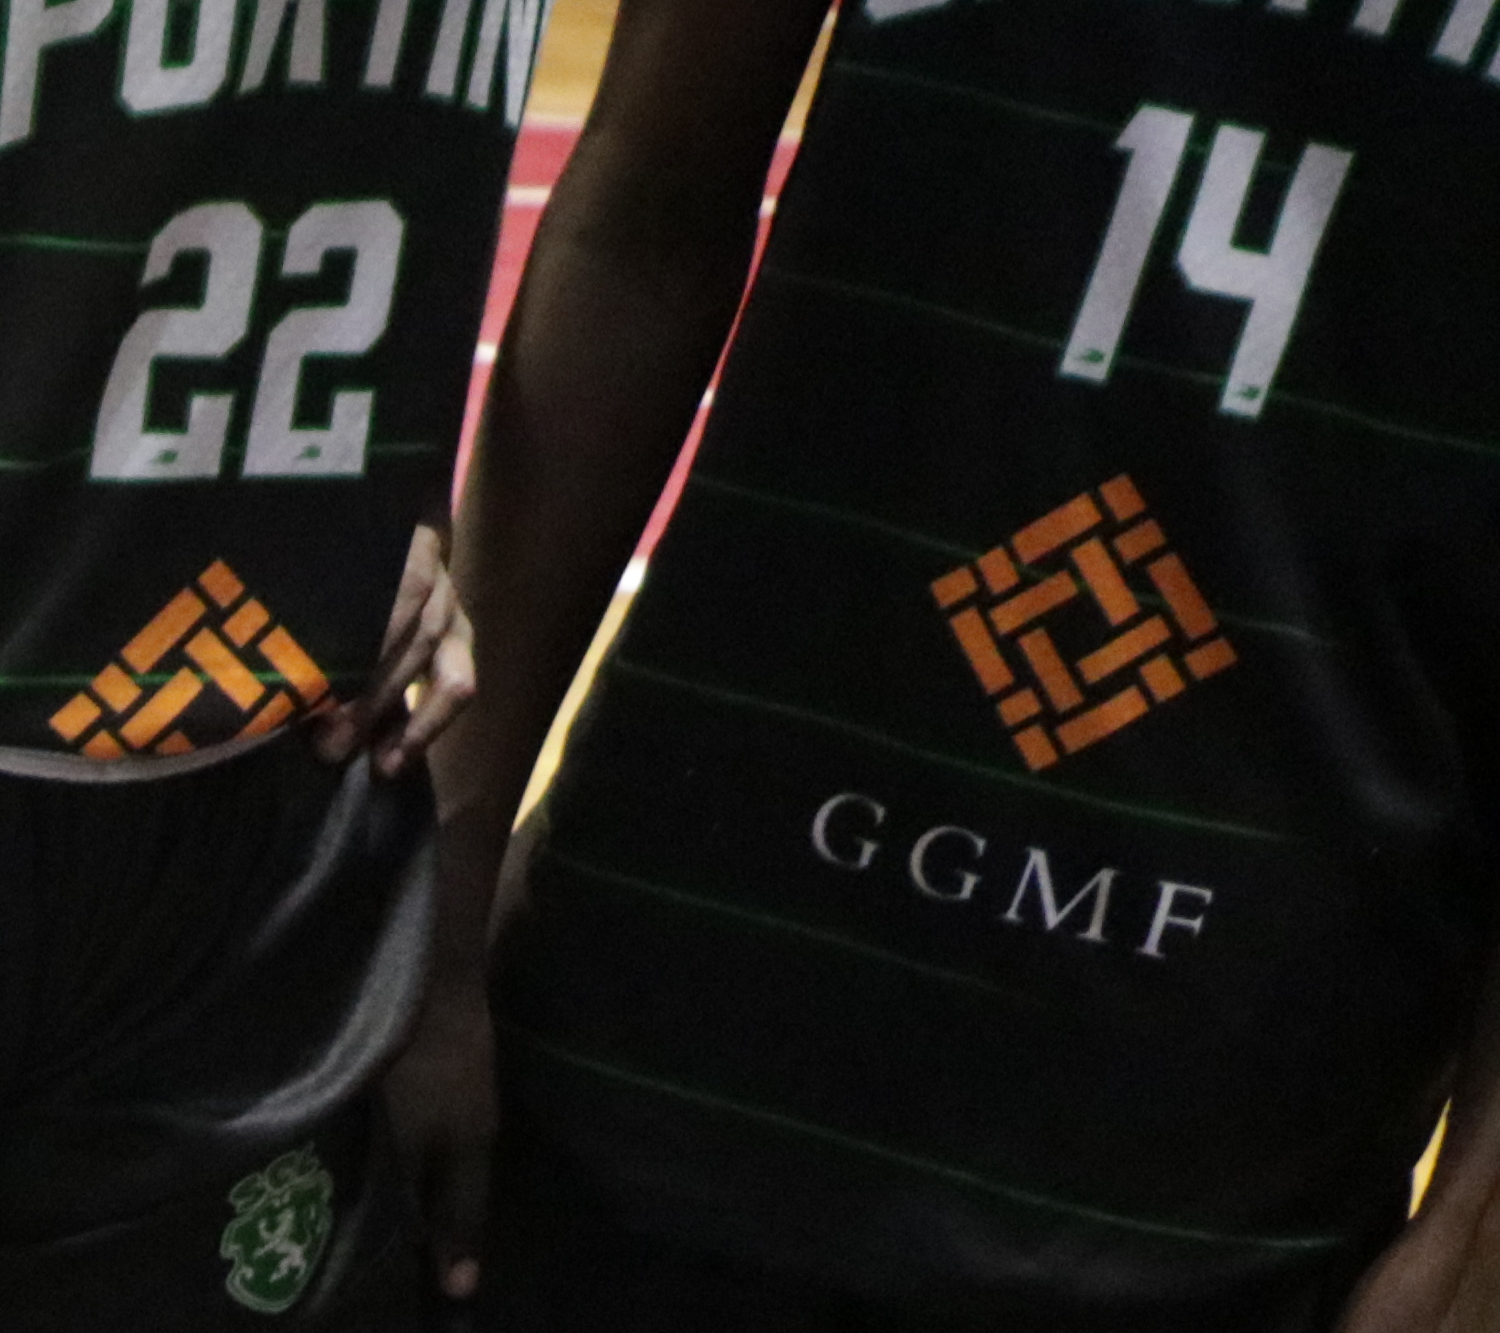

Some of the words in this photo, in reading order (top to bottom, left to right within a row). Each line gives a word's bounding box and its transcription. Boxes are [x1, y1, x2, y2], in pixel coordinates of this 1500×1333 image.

[90, 199, 405, 480] 22
[1058, 102, 1353, 419] 14
[811, 792, 1213, 960] GGMF
